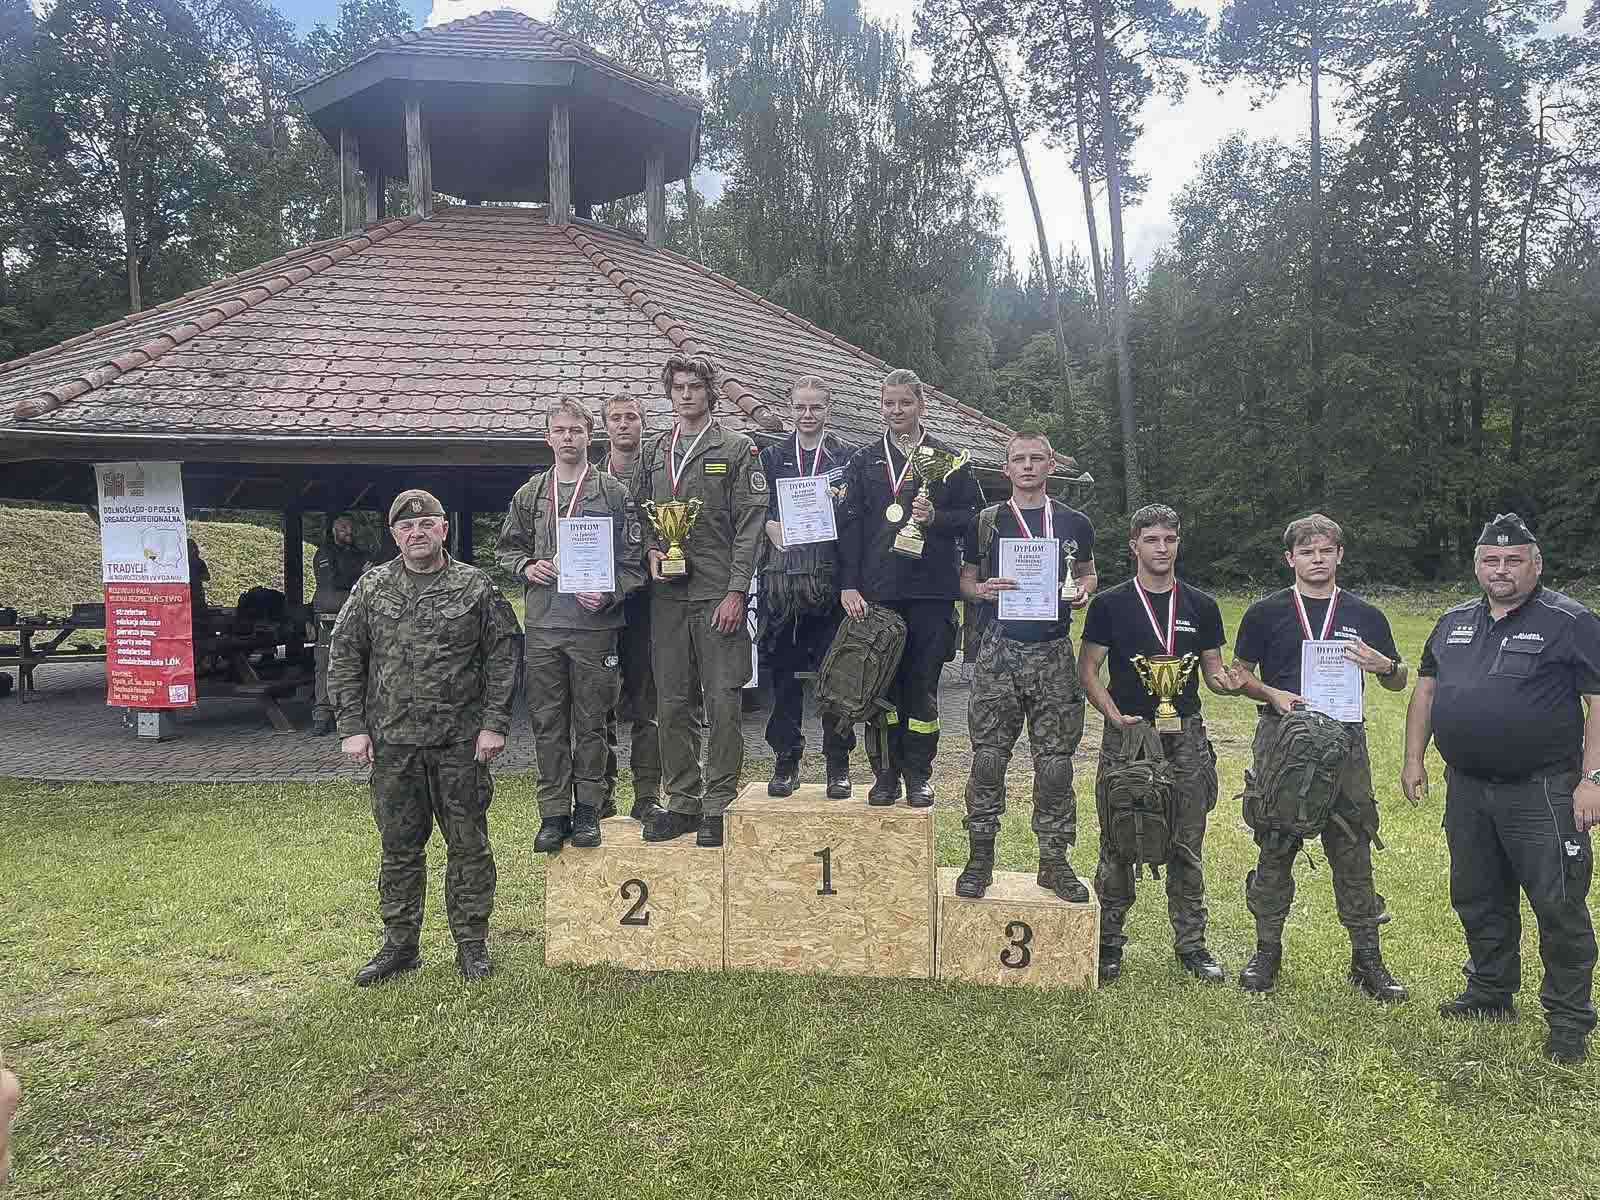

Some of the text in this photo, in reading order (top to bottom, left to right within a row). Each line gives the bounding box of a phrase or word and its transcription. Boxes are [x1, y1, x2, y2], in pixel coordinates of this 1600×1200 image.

[789, 481, 816, 491] DYPLOM
[570, 523, 599, 531] DYPLOM
[1014, 544, 1045, 553] DYPLOM
[165, 657, 181, 666] LOK
[814, 847, 837, 896] 1
[620, 879, 649, 926] 2
[1000, 921, 1032, 969] 3
